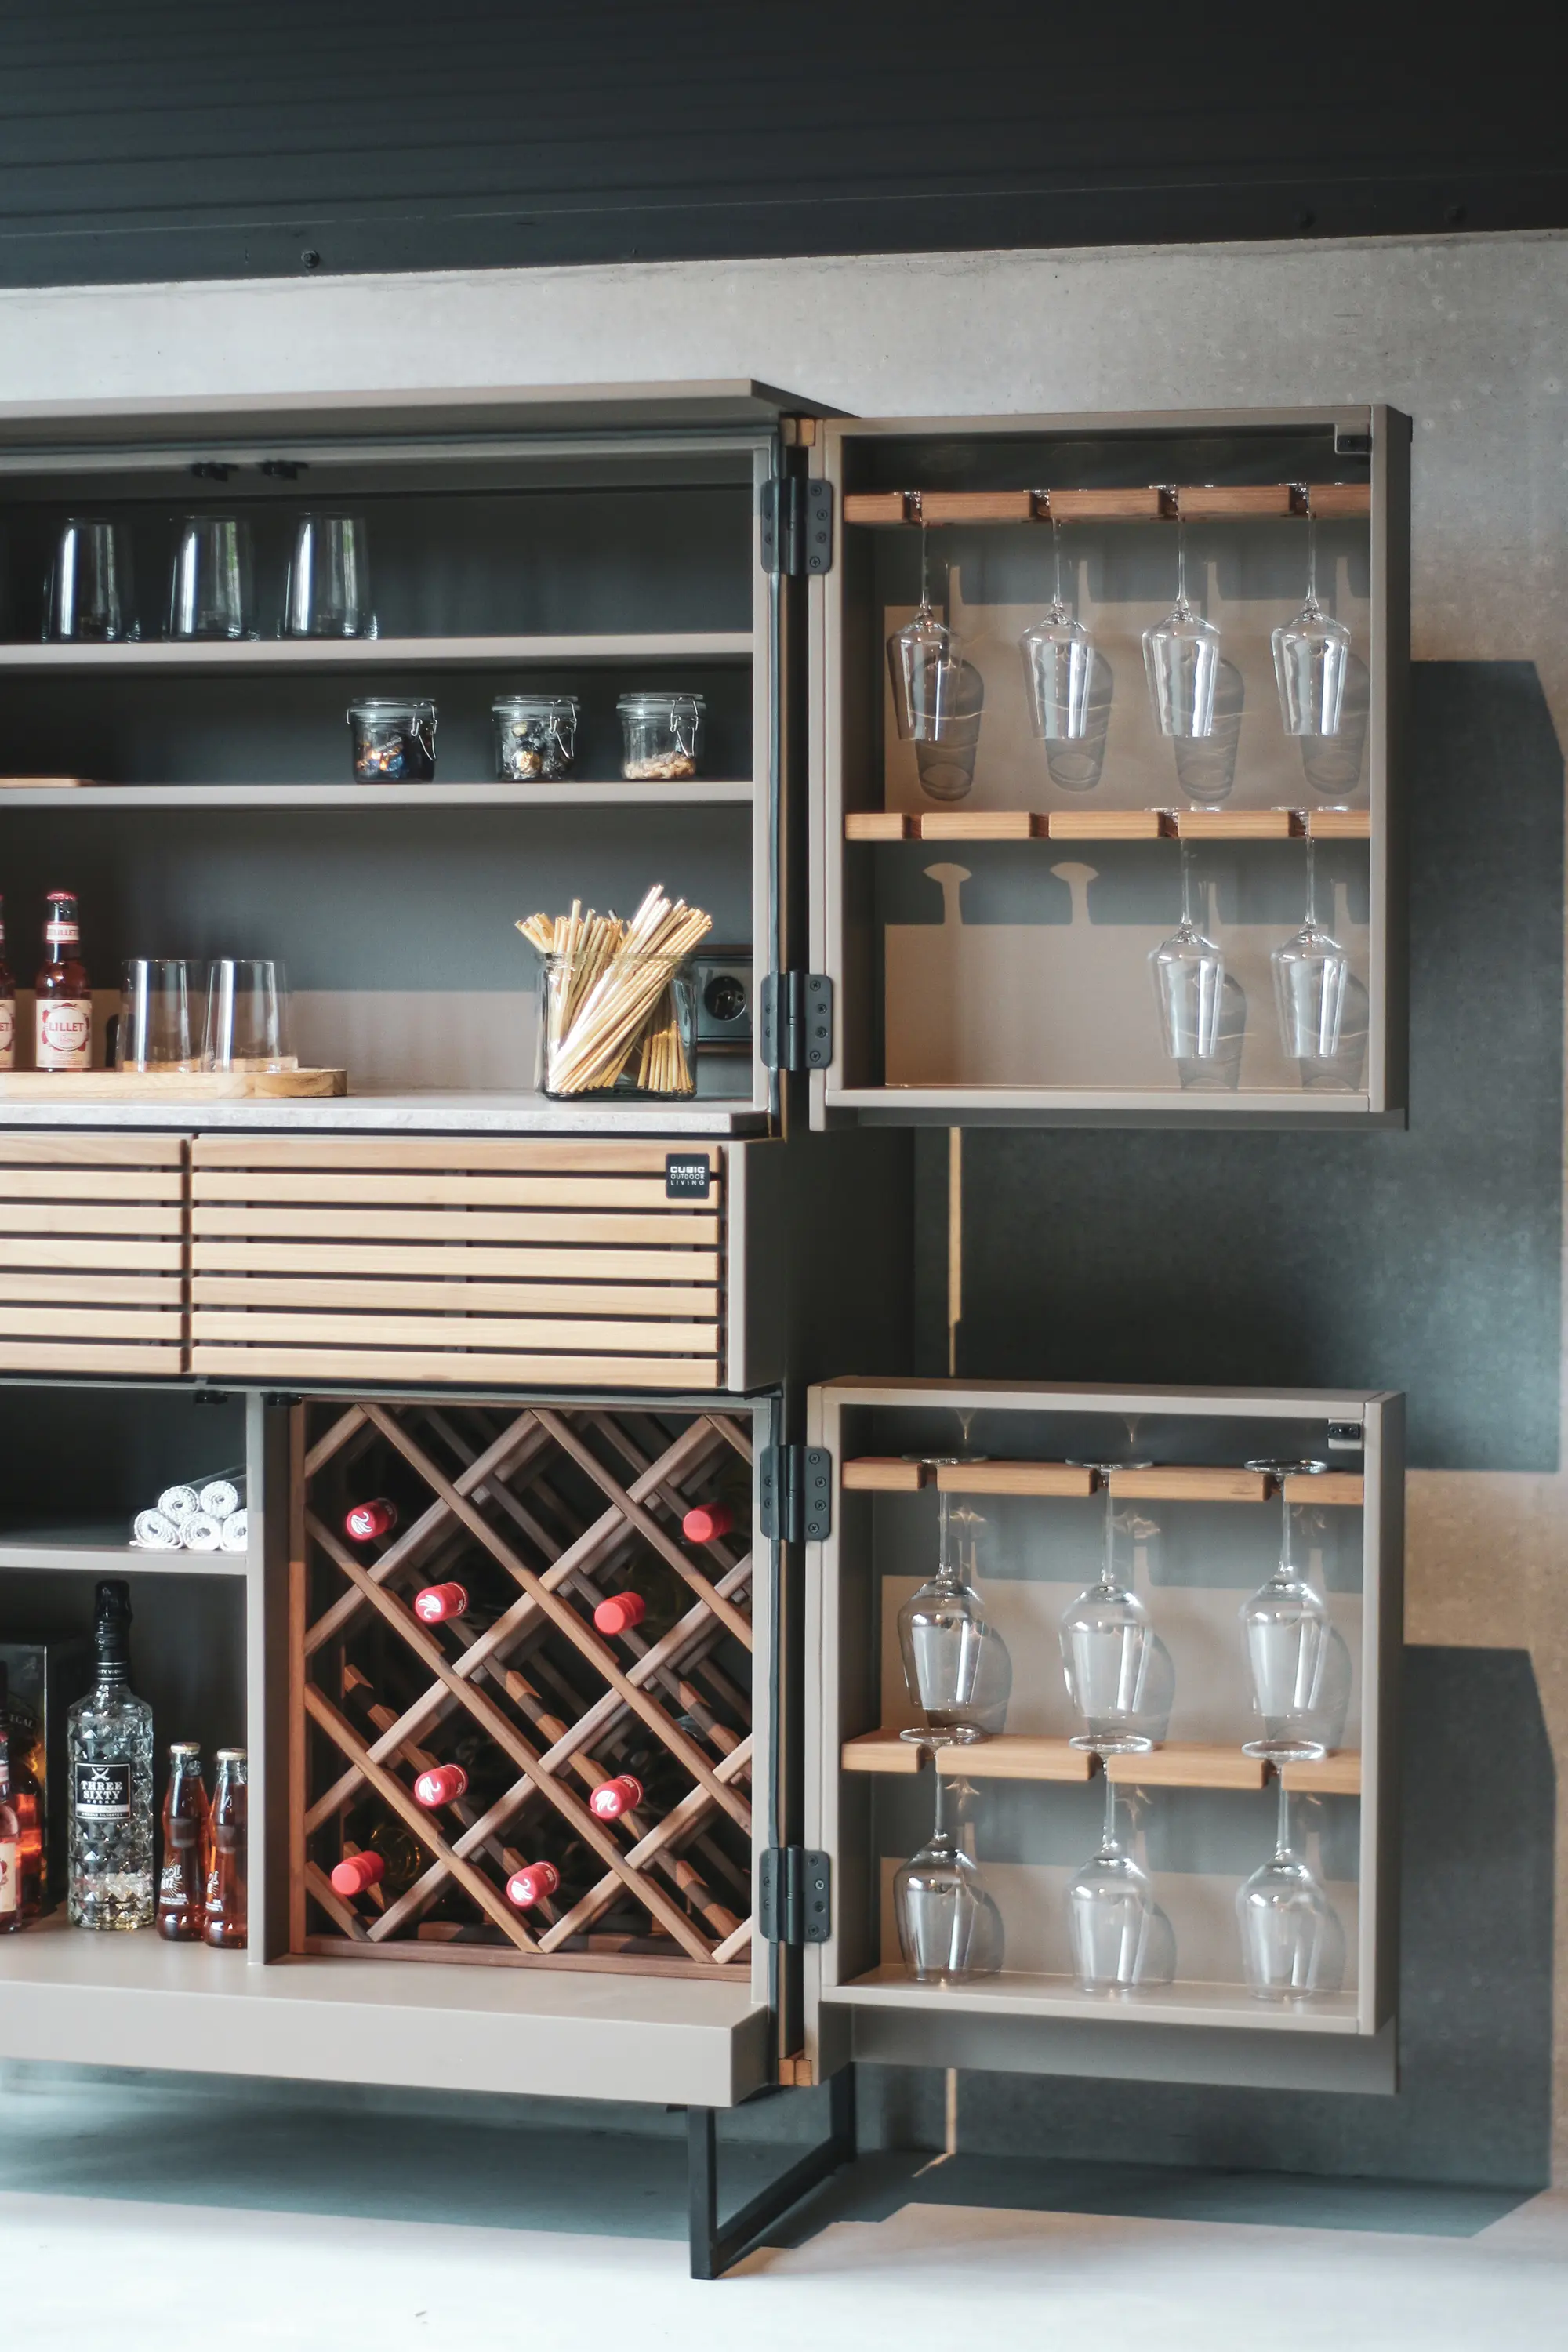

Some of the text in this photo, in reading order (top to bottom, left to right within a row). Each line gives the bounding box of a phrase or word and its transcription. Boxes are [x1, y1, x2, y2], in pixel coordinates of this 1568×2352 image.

[49, 1022, 84, 1032] LILLET
[81, 1780, 123, 1791] THREE
[83, 1790, 120, 1800] SIXTY
